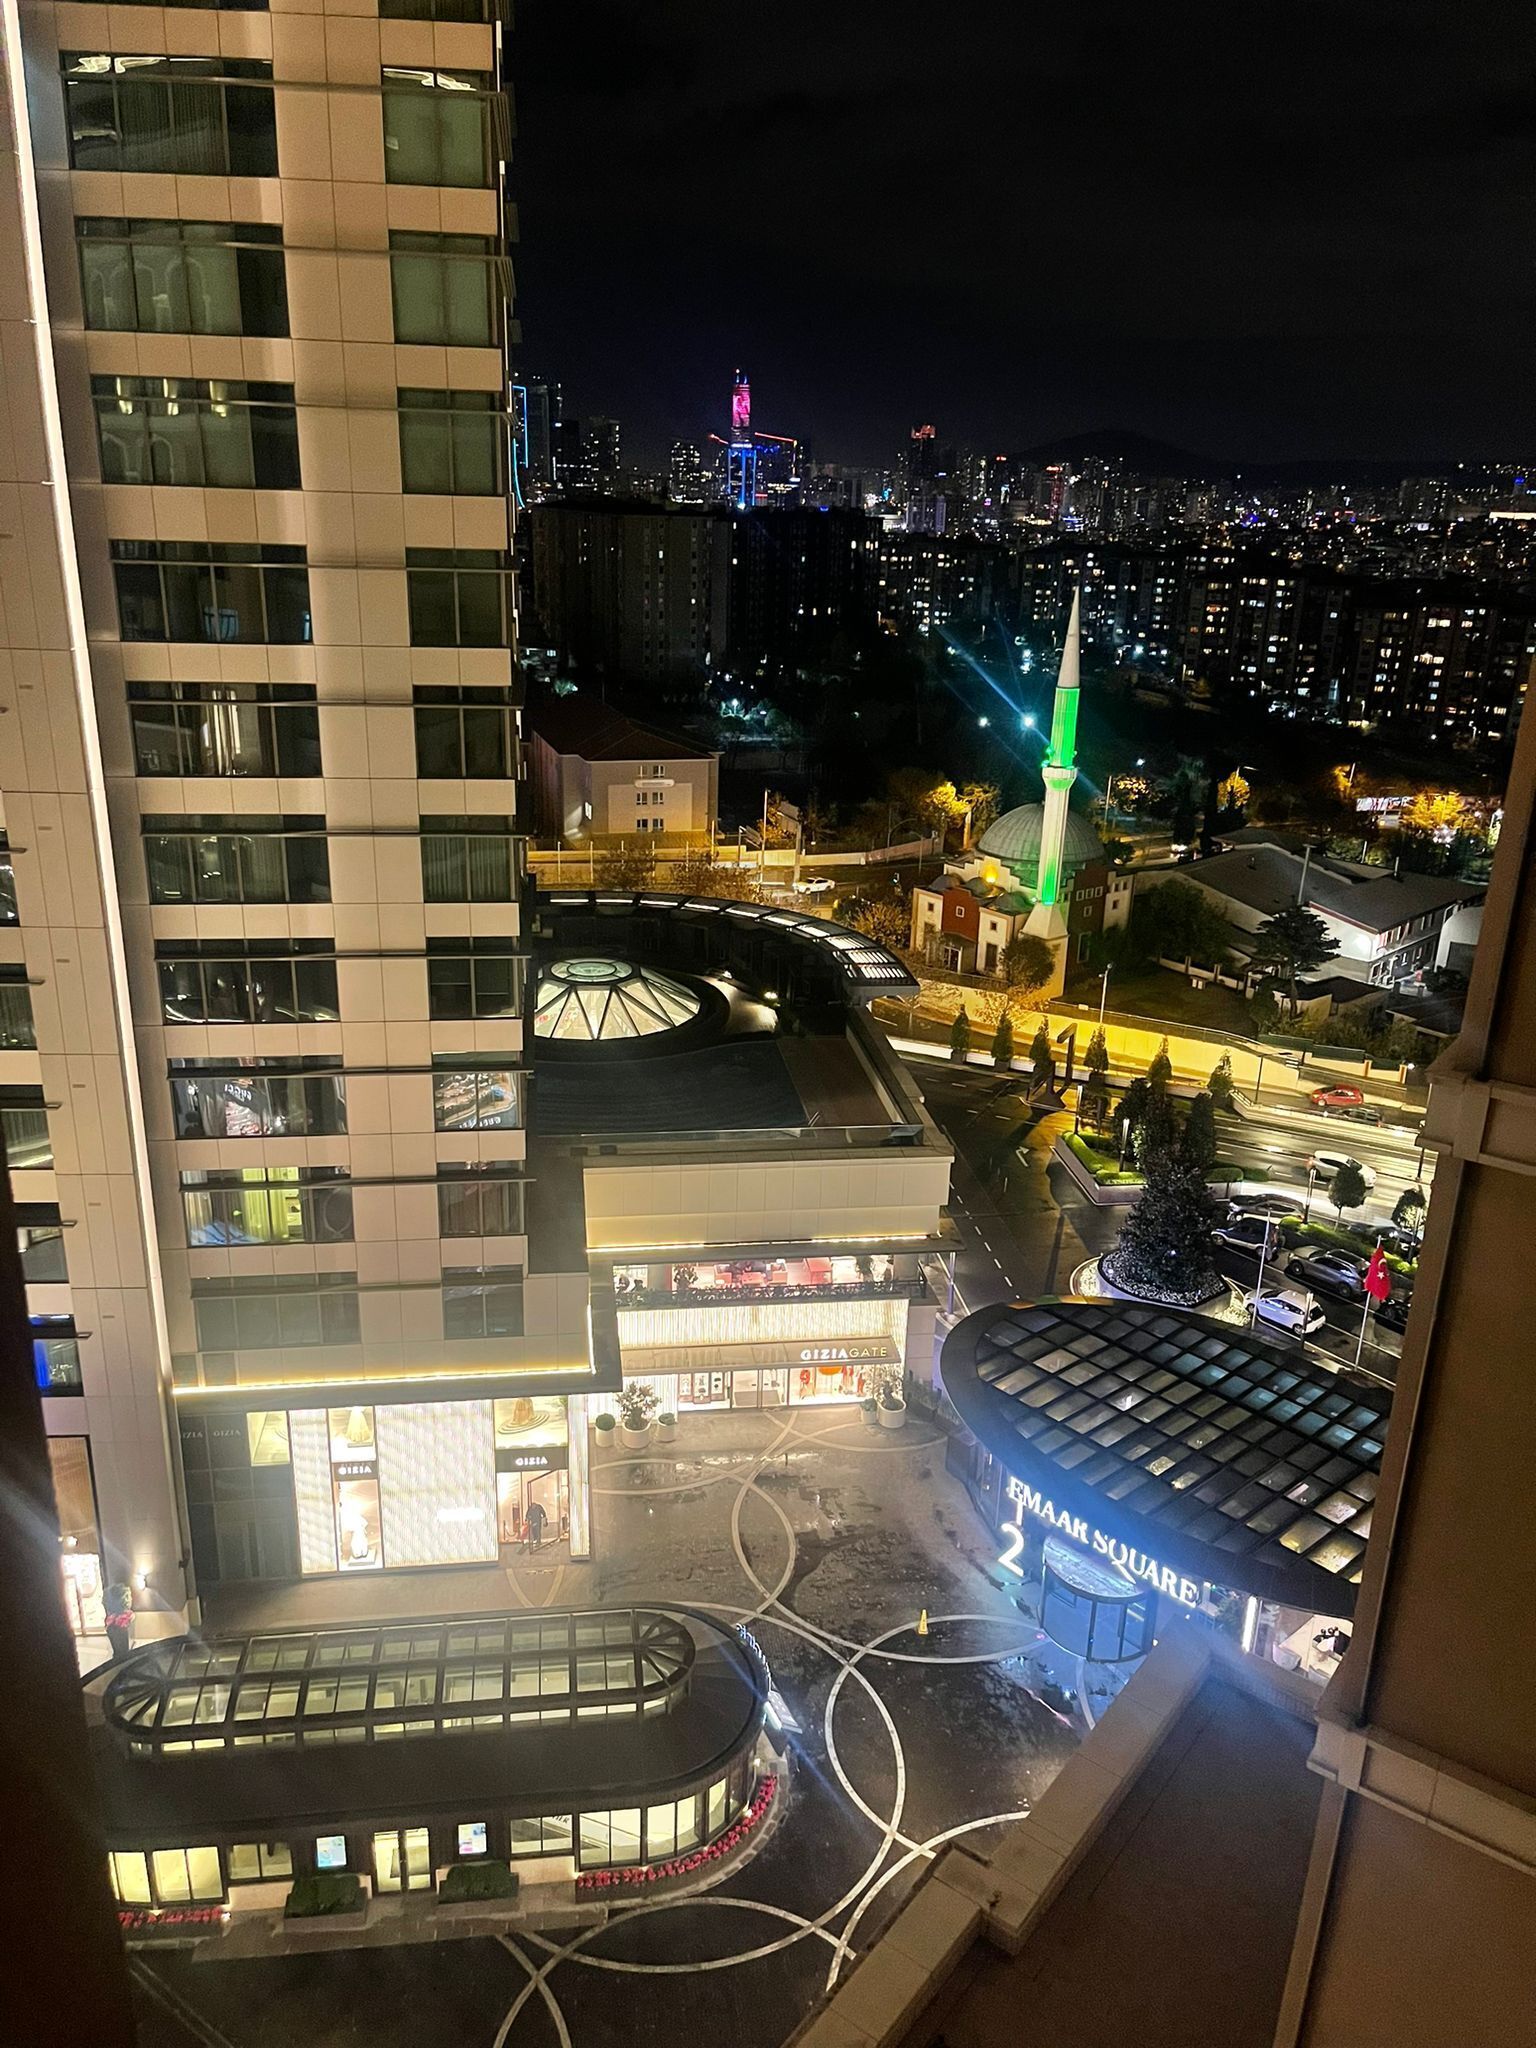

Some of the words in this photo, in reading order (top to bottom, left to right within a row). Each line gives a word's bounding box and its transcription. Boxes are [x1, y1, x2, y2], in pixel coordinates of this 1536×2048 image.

[997, 1522, 1025, 1577] 2
[1006, 1475, 1090, 1545] EMAAR
[1092, 1528, 1199, 1609] SQUARE
